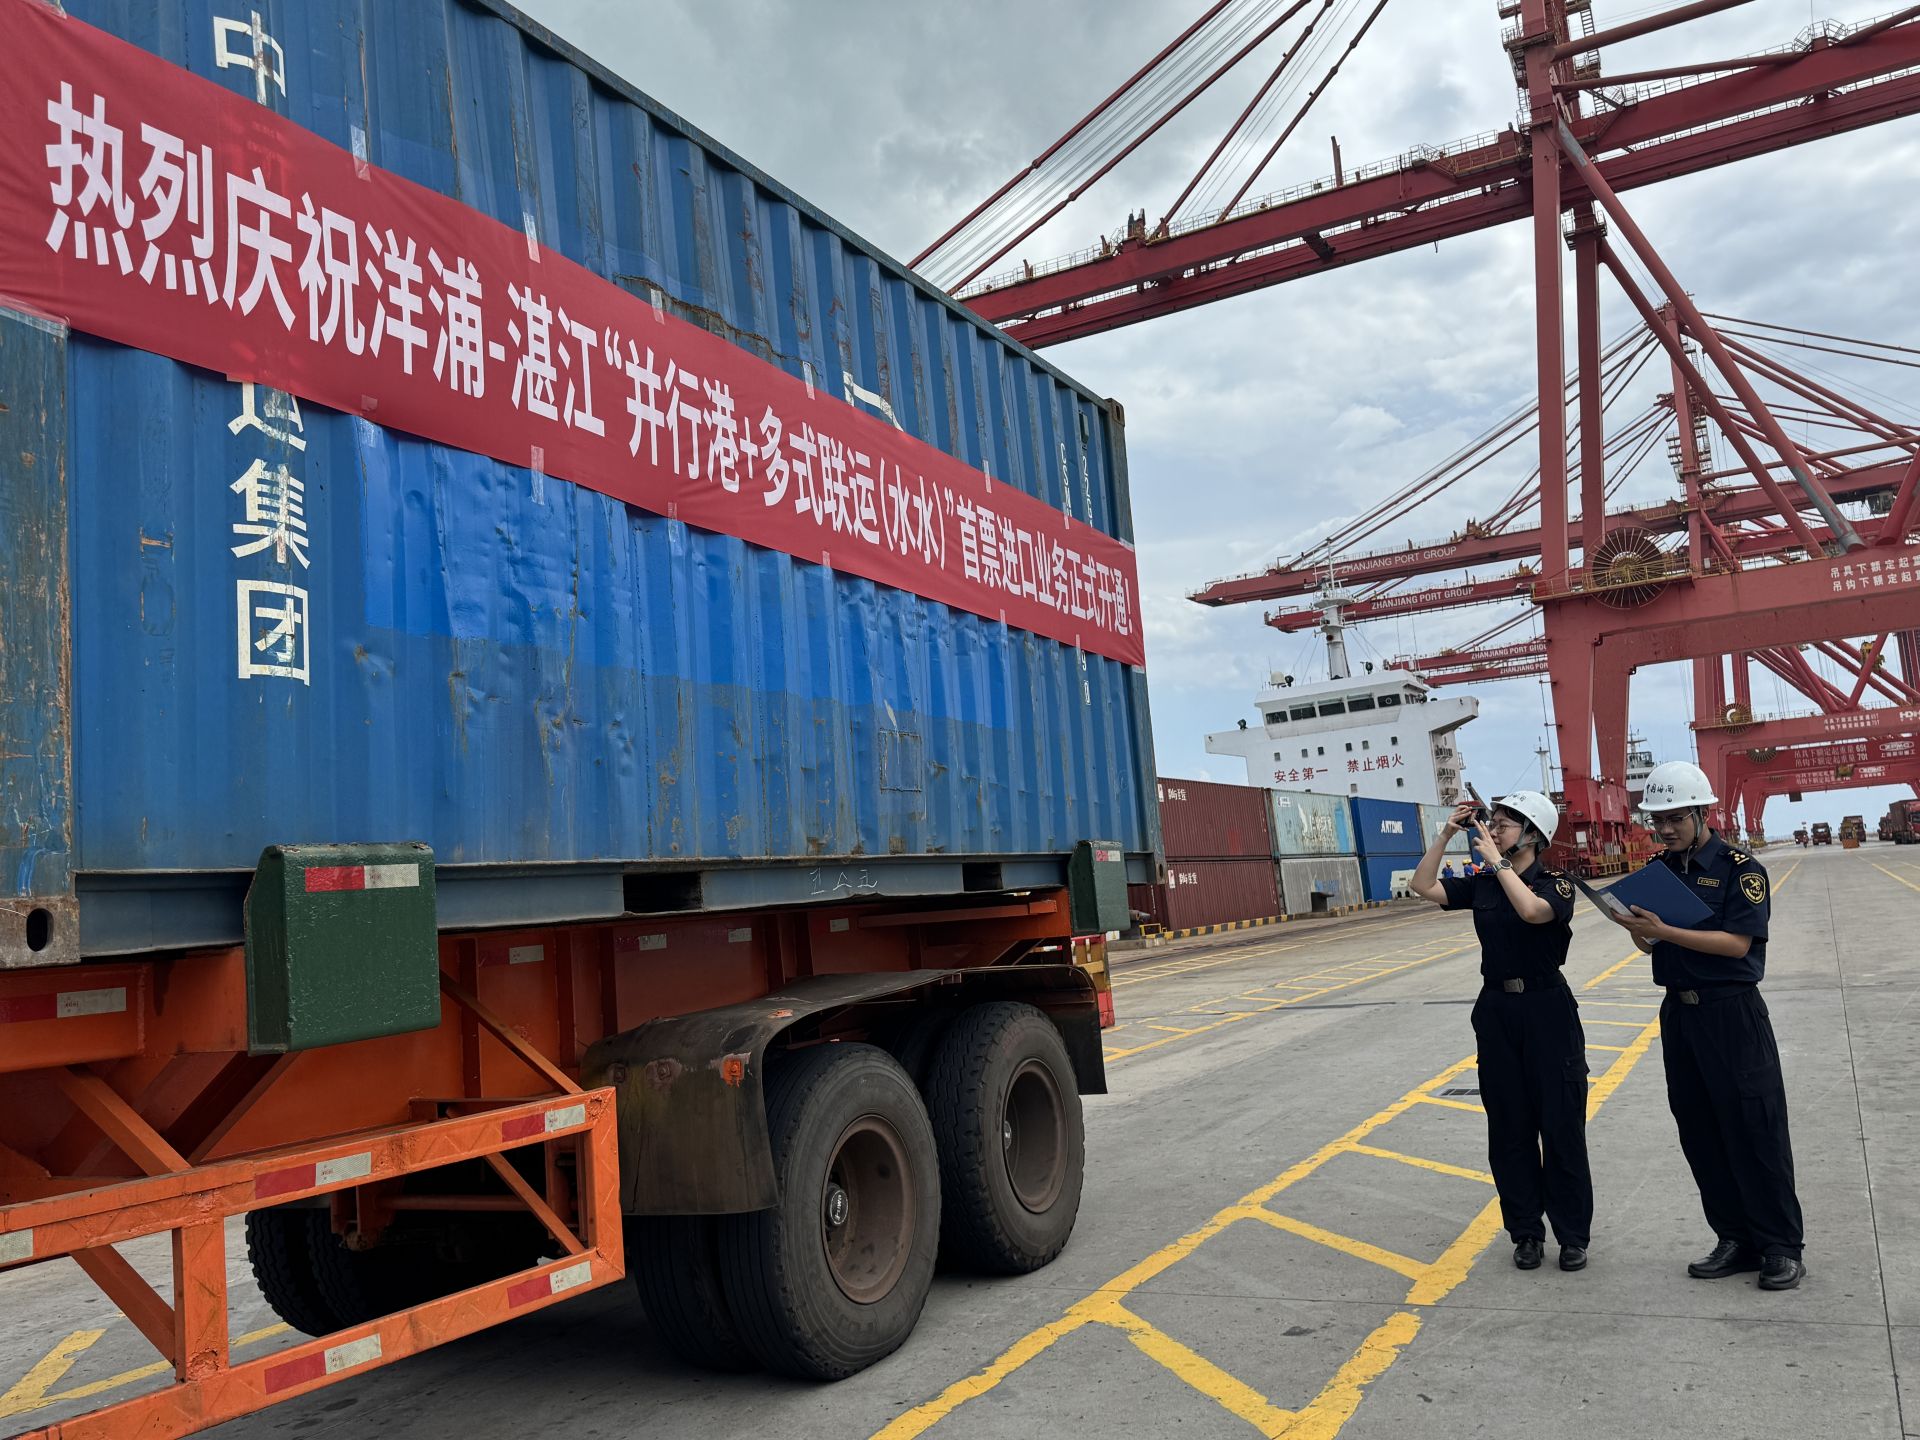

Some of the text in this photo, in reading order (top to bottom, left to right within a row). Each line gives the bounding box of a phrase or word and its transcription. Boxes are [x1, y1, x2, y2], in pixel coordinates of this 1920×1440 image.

[1394, 552, 1420, 565] PORT
[1423, 546, 1457, 559] GROUP
[1371, 587, 1474, 610] ZHANJIANG PORT GROUP
[1471, 649, 1508, 660] ZHANJIANG
[1509, 646, 1527, 655] PORT
[1500, 664, 1535, 674] ZHANJIANG
[1274, 753, 1404, 783] 安全第一 禁止烟火
